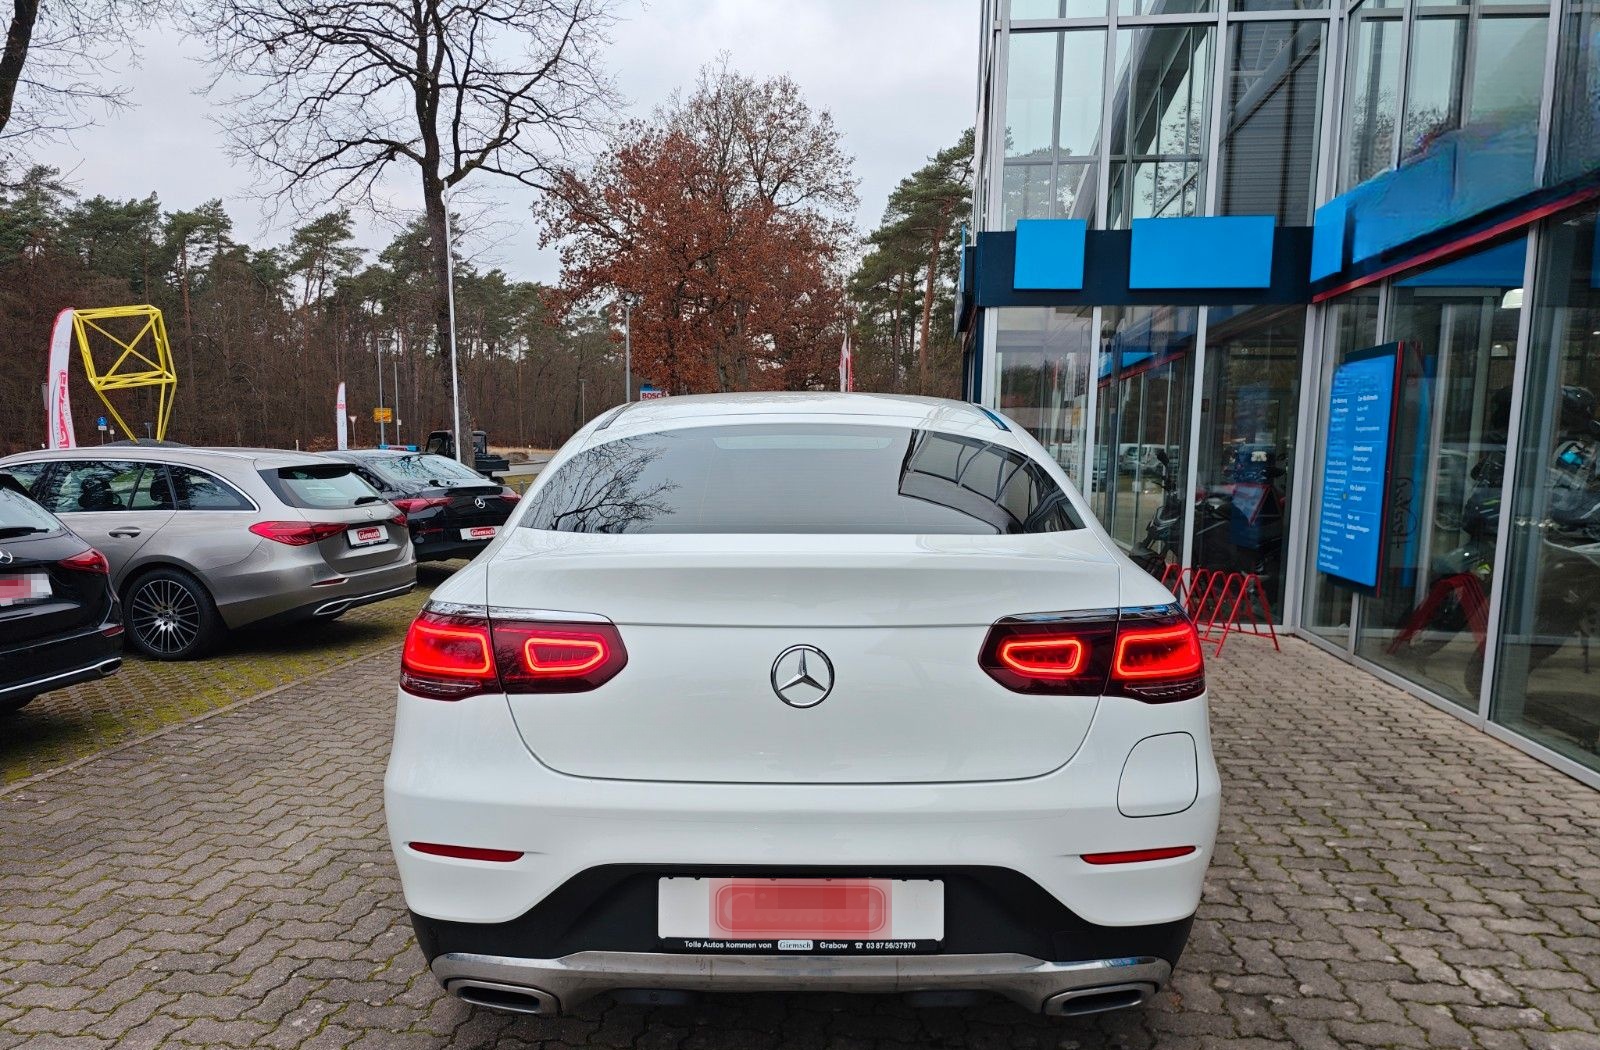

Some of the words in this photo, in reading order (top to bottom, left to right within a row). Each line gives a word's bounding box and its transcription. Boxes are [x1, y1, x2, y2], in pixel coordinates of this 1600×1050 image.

[684, 940, 702, 949] Tolle
[703, 941, 724, 949] Autos
[726, 941, 757, 949] kommen
[779, 940, 812, 950] Giemsch
[820, 941, 848, 950] Grabow
